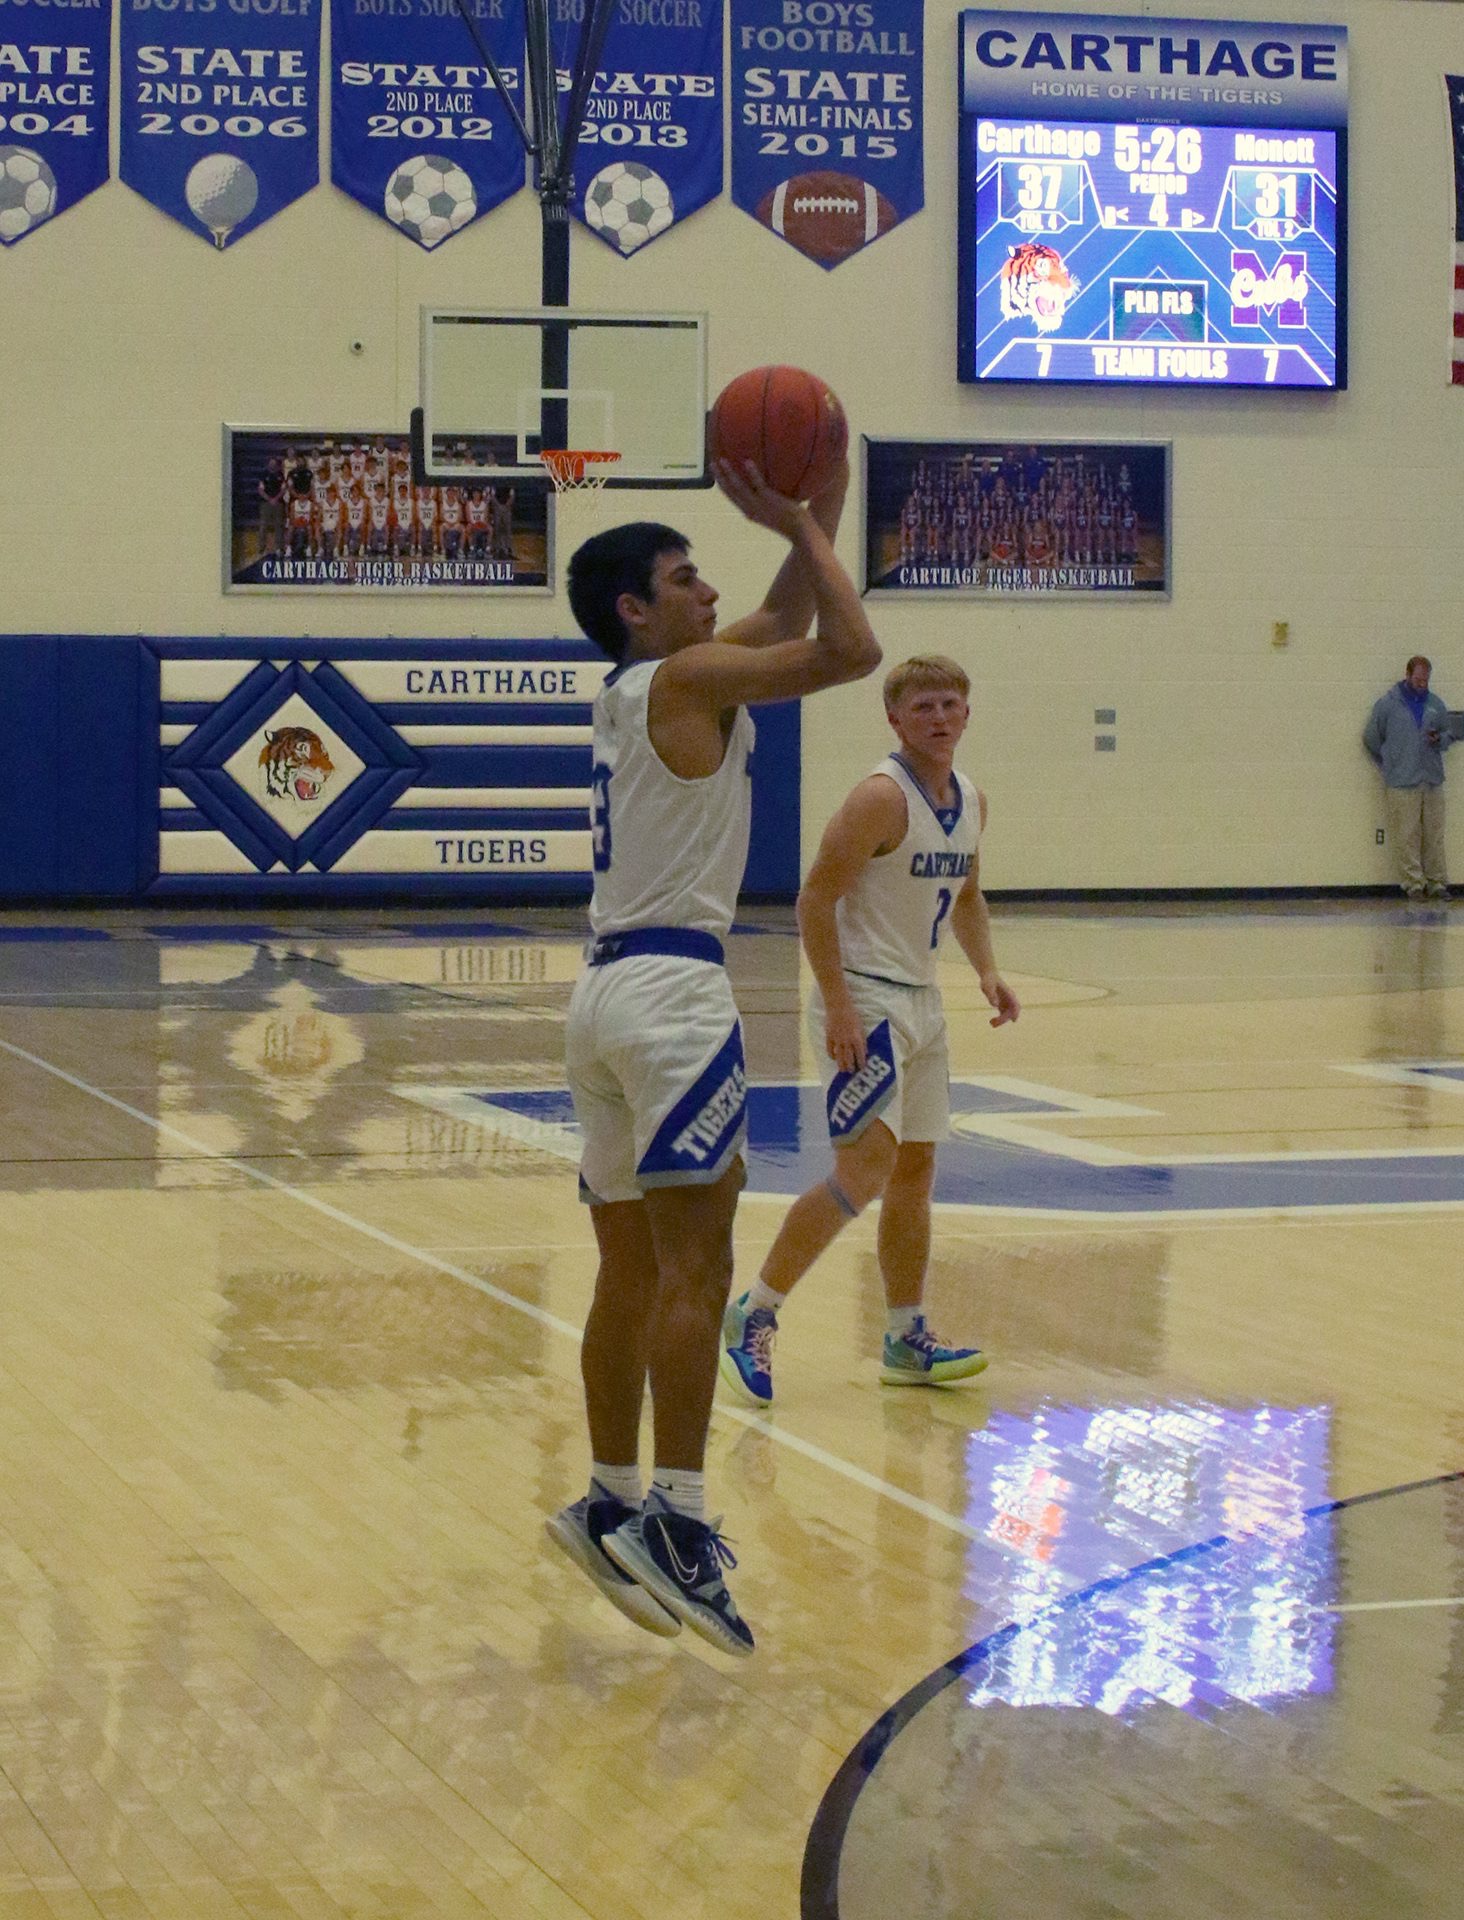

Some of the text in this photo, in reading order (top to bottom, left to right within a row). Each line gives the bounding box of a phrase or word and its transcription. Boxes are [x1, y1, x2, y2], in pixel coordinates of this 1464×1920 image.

[419, 0, 504, 19] SOCER
[619, 0, 703, 27] SOCCER
[782, 1, 874, 26] BOYS
[741, 27, 915, 56] FOOTBALL
[137, 46, 308, 78] STATE
[976, 29, 1337, 81] CARTHAGE
[341, 62, 518, 89] STATE
[744, 67, 911, 103] STATE
[0, 82, 95, 105] PLACE
[137, 82, 308, 107] 2ND PLACE
[386, 91, 473, 113] 2ND PLACE
[1032, 81, 1283, 106] HOME OF THE TIGERS
[587, 99, 671, 121] 2ND PLACE
[743, 103, 913, 130] SEMI-FINALS
[0, 113, 94, 136] 04
[138, 113, 307, 137] 2006
[367, 115, 493, 140] 2012
[578, 121, 688, 147] 2013
[758, 132, 898, 159] 2015
[977, 121, 1101, 156] Carthage
[1114, 125, 1202, 174] 5:26
[1235, 133, 1315, 164] Monett
[1018, 164, 1062, 210] 37
[1130, 174, 1187, 194] PERIOD
[1256, 172, 1296, 217] 31
[1149, 193, 1168, 227] 4
[1284, 221, 1294, 237] 2
[1124, 290, 1194, 315] PLR FLS
[1036, 345, 1053, 377] 7
[1092, 347, 1227, 379] TEAM FOULS
[1264, 350, 1279, 382] 7
[262, 561, 514, 581] CARTHAGE TIGER BASKETBALL
[900, 567, 1135, 586] CARTHAGE TIGER BASKETBALL
[406, 669, 576, 694] CARTHAGE
[436, 840, 547, 864] TIGERS
[831, 1054, 891, 1129] TIGERS
